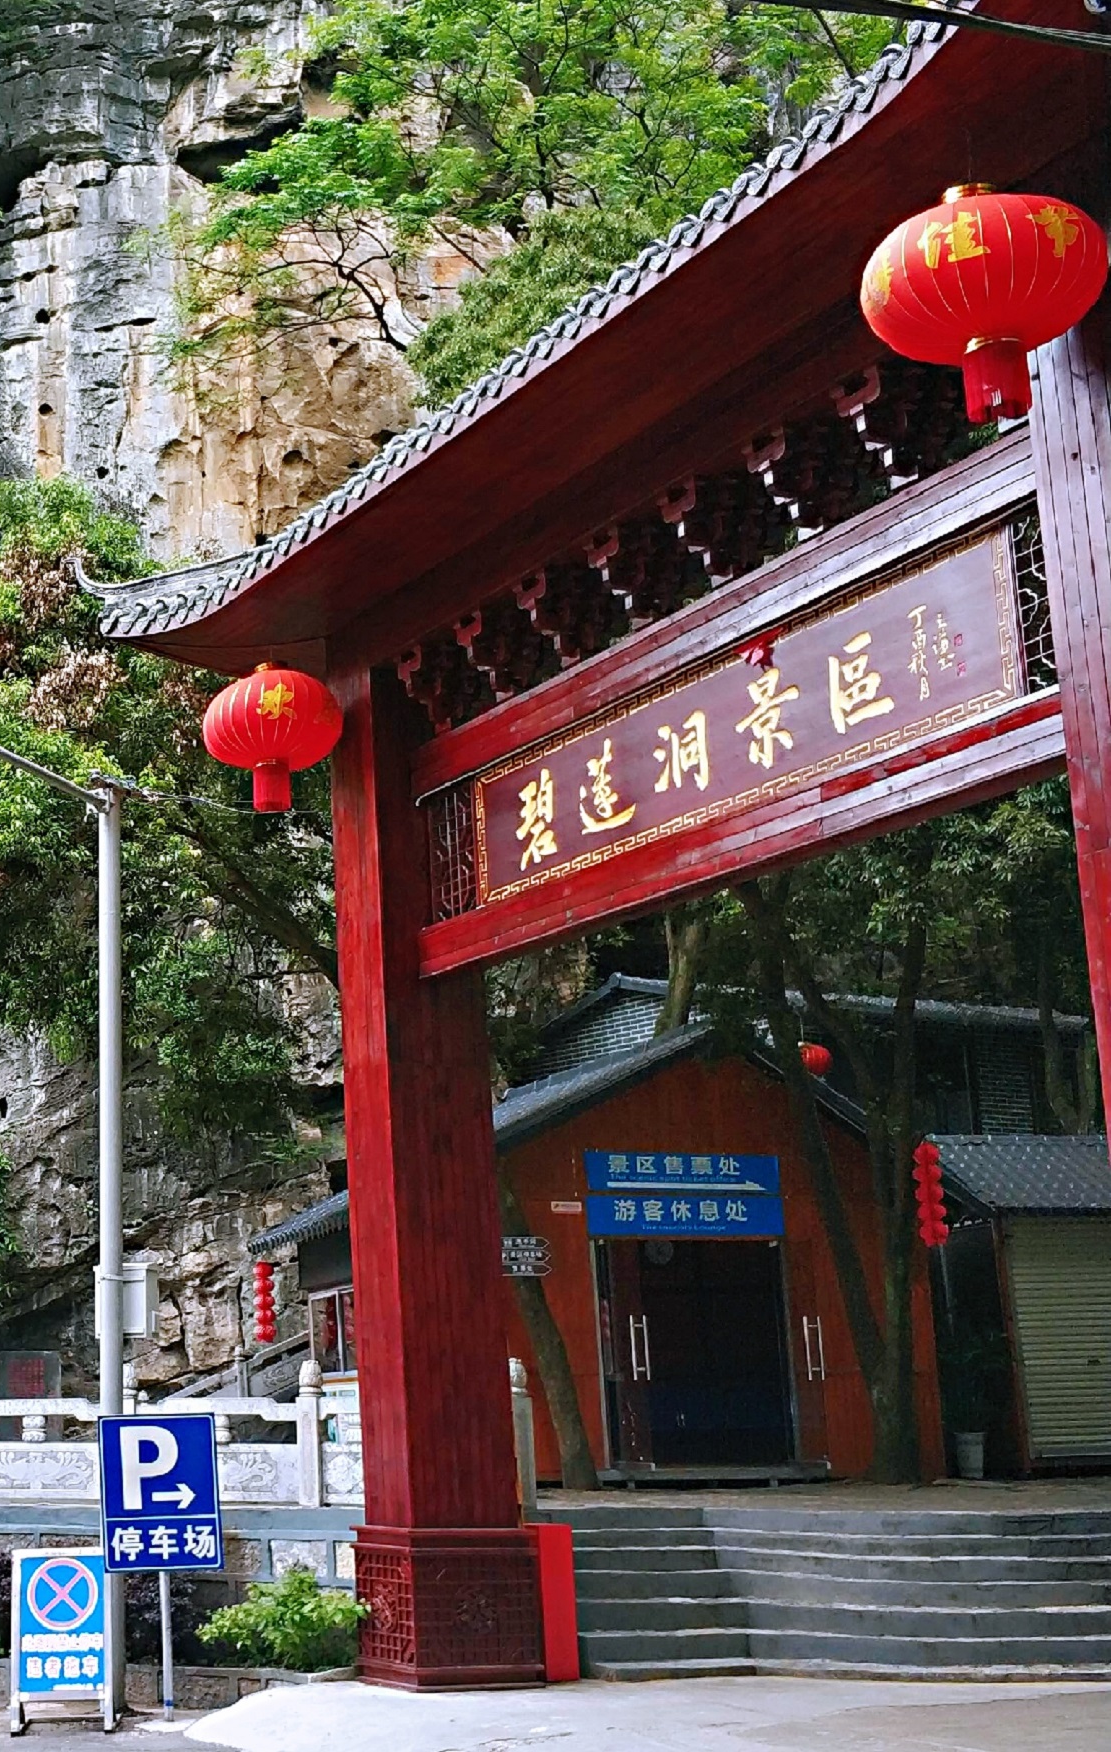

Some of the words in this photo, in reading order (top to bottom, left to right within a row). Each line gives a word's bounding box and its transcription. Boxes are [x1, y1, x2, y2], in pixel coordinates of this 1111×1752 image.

[607, 1154, 742, 1176] 景区售票处
[614, 1200, 748, 1222] 游客休息处
[119, 1425, 179, 1511] P
[111, 1524, 216, 1561] 停车场
